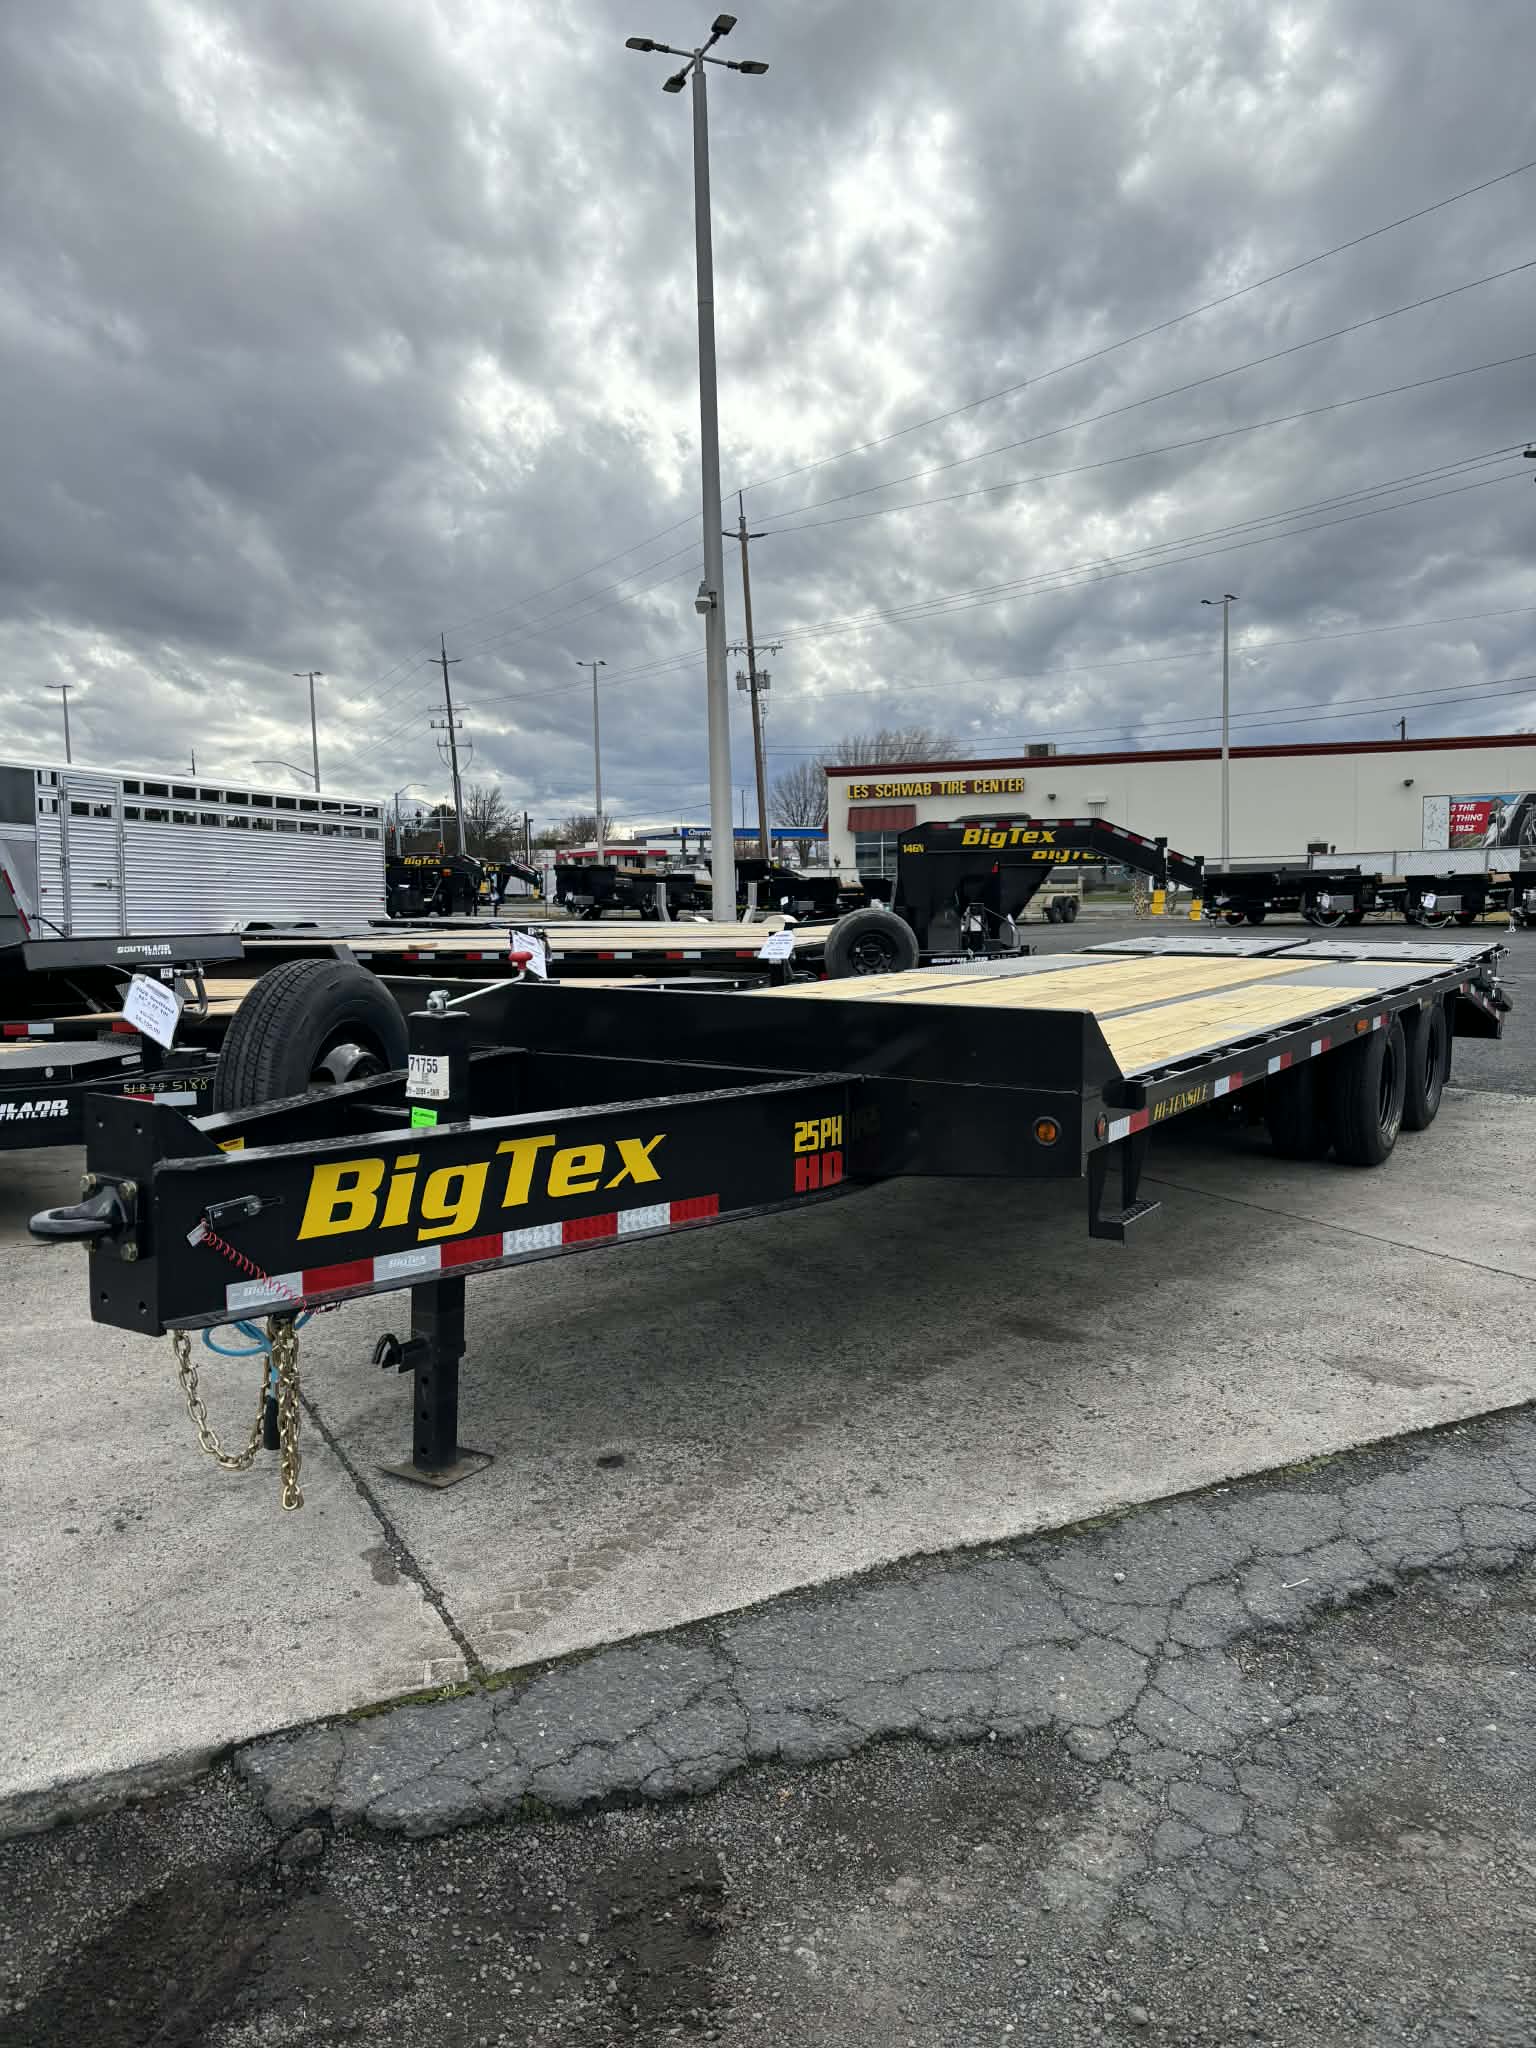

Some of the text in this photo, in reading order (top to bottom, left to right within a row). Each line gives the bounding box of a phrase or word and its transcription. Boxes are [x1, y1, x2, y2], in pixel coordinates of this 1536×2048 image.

[847, 778, 1025, 799] LES SCHWAB TIRE CENTER
[1456, 814, 1483, 822] THING
[1458, 804, 1476, 812] THE
[962, 828, 1057, 849] BigTex
[404, 855, 441, 865] BigTex
[117, 944, 170, 954] SOUTHLAND
[409, 1056, 438, 1074] 71755
[1154, 1083, 1207, 1121] HI-TENSILE
[794, 1115, 843, 1153] 25PH
[794, 1150, 843, 1193] HD
[296, 1133, 667, 1242] BigTex
